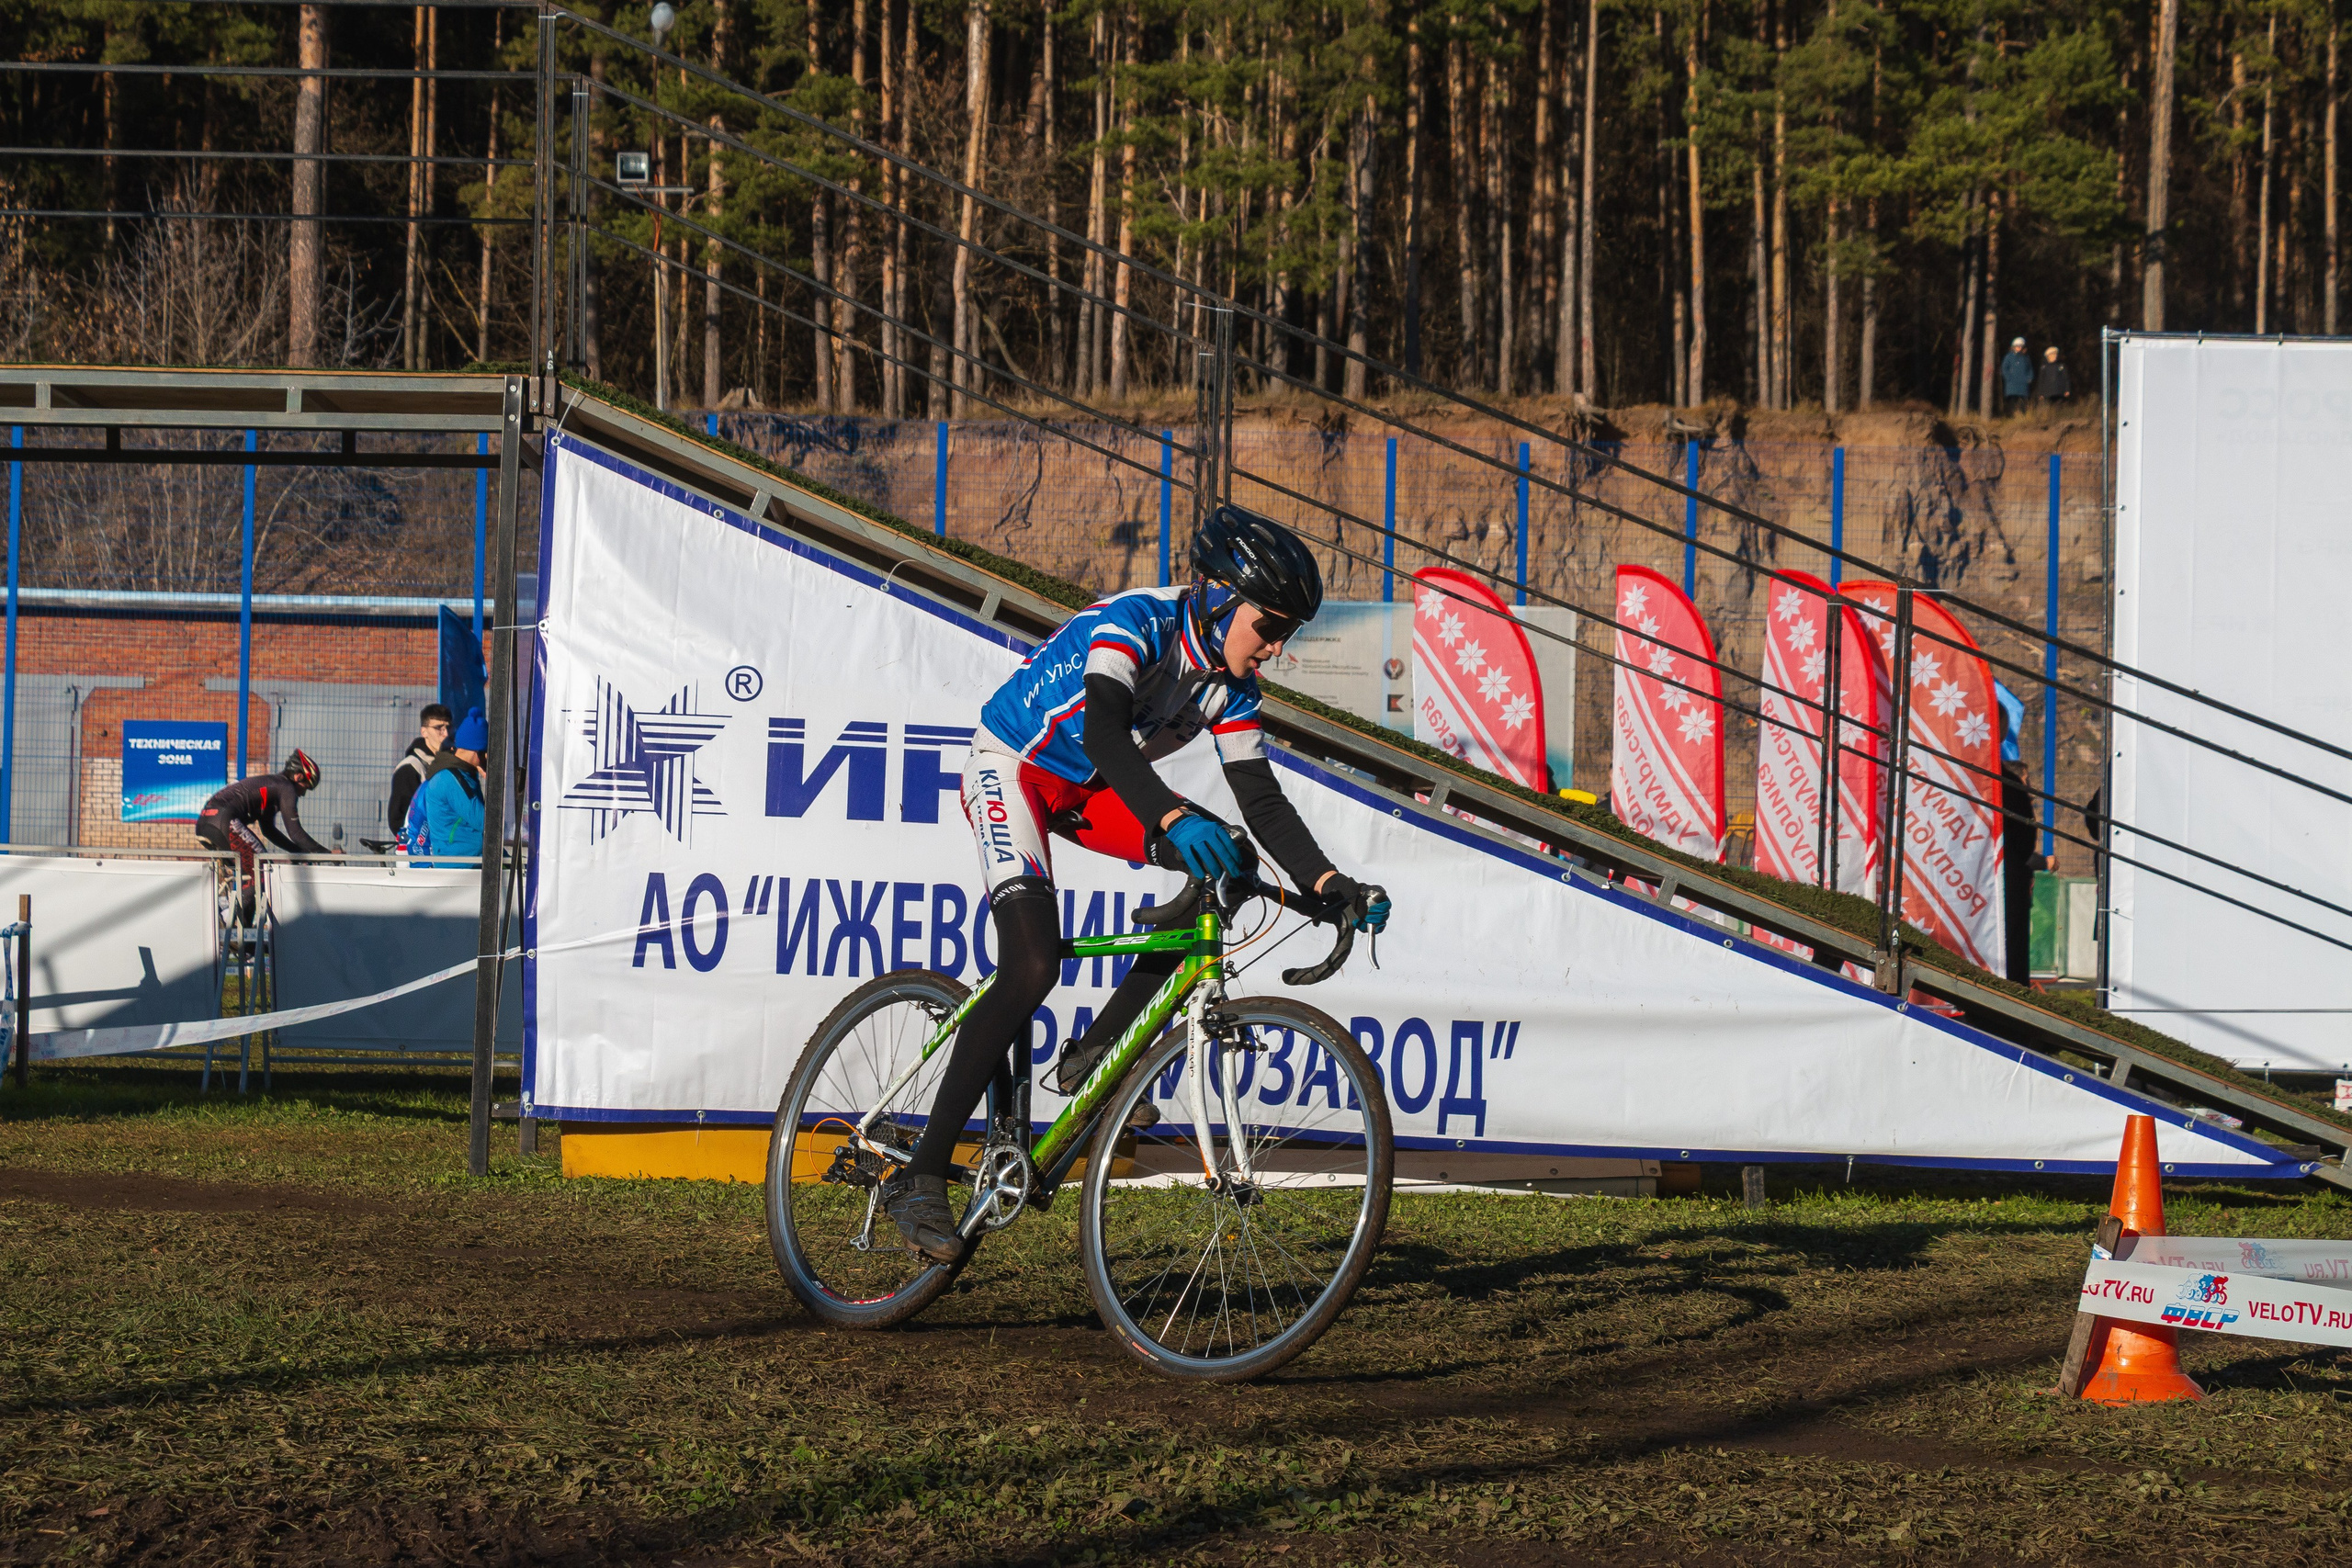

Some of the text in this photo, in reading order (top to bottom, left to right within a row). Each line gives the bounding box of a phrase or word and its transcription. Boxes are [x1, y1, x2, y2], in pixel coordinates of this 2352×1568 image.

[129, 739, 220, 750] ТЕХНИЧЕСКАЯ
[158, 754, 193, 765] ЗОНА
[765, 716, 979, 824] ИР
[992, 883, 1027, 906] CANYON
[632, 872, 729, 973] АО
[2160, 1302, 2241, 1330] ФВСР
